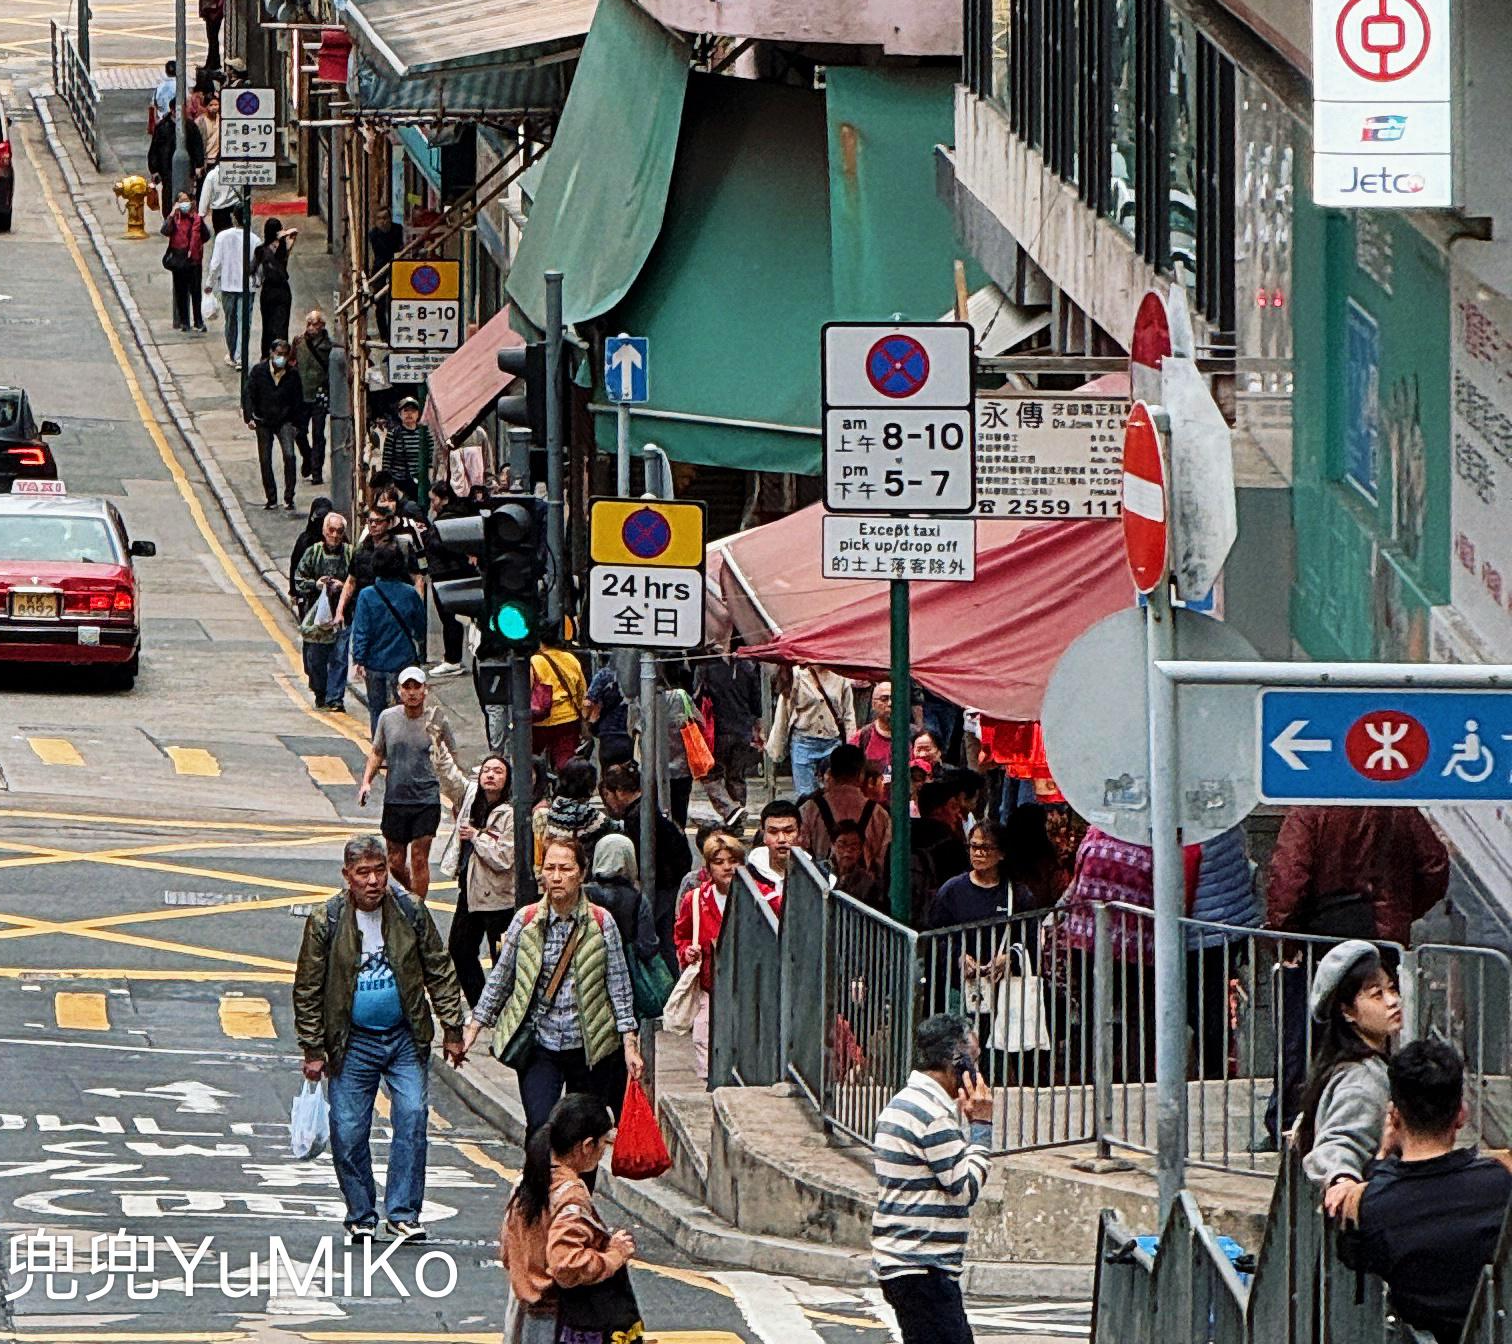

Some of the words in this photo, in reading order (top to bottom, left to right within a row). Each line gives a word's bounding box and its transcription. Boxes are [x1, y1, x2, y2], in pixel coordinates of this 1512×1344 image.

[417, 306, 456, 321] 8-10
[417, 328, 449, 343] 5-7
[842, 418, 868, 430] am
[980, 401, 1045, 429] 永傳
[834, 434, 877, 454] 上午
[882, 423, 964, 450] 8-10
[842, 465, 869, 478] pm
[16, 481, 62, 493] TAXI
[834, 482, 878, 501] 下午
[1007, 499, 1071, 515] 2559
[1082, 499, 1122, 515] 111
[859, 523, 910, 540] Except
[913, 524, 941, 537] taxi
[839, 537, 870, 552] pick
[874, 538, 933, 555] up/drop
[937, 540, 958, 552] off
[831, 555, 966, 577] 的士上落客除外
[601, 573, 637, 597] 24
[644, 575, 690, 600] hrs
[614, 605, 678, 638] 全日
